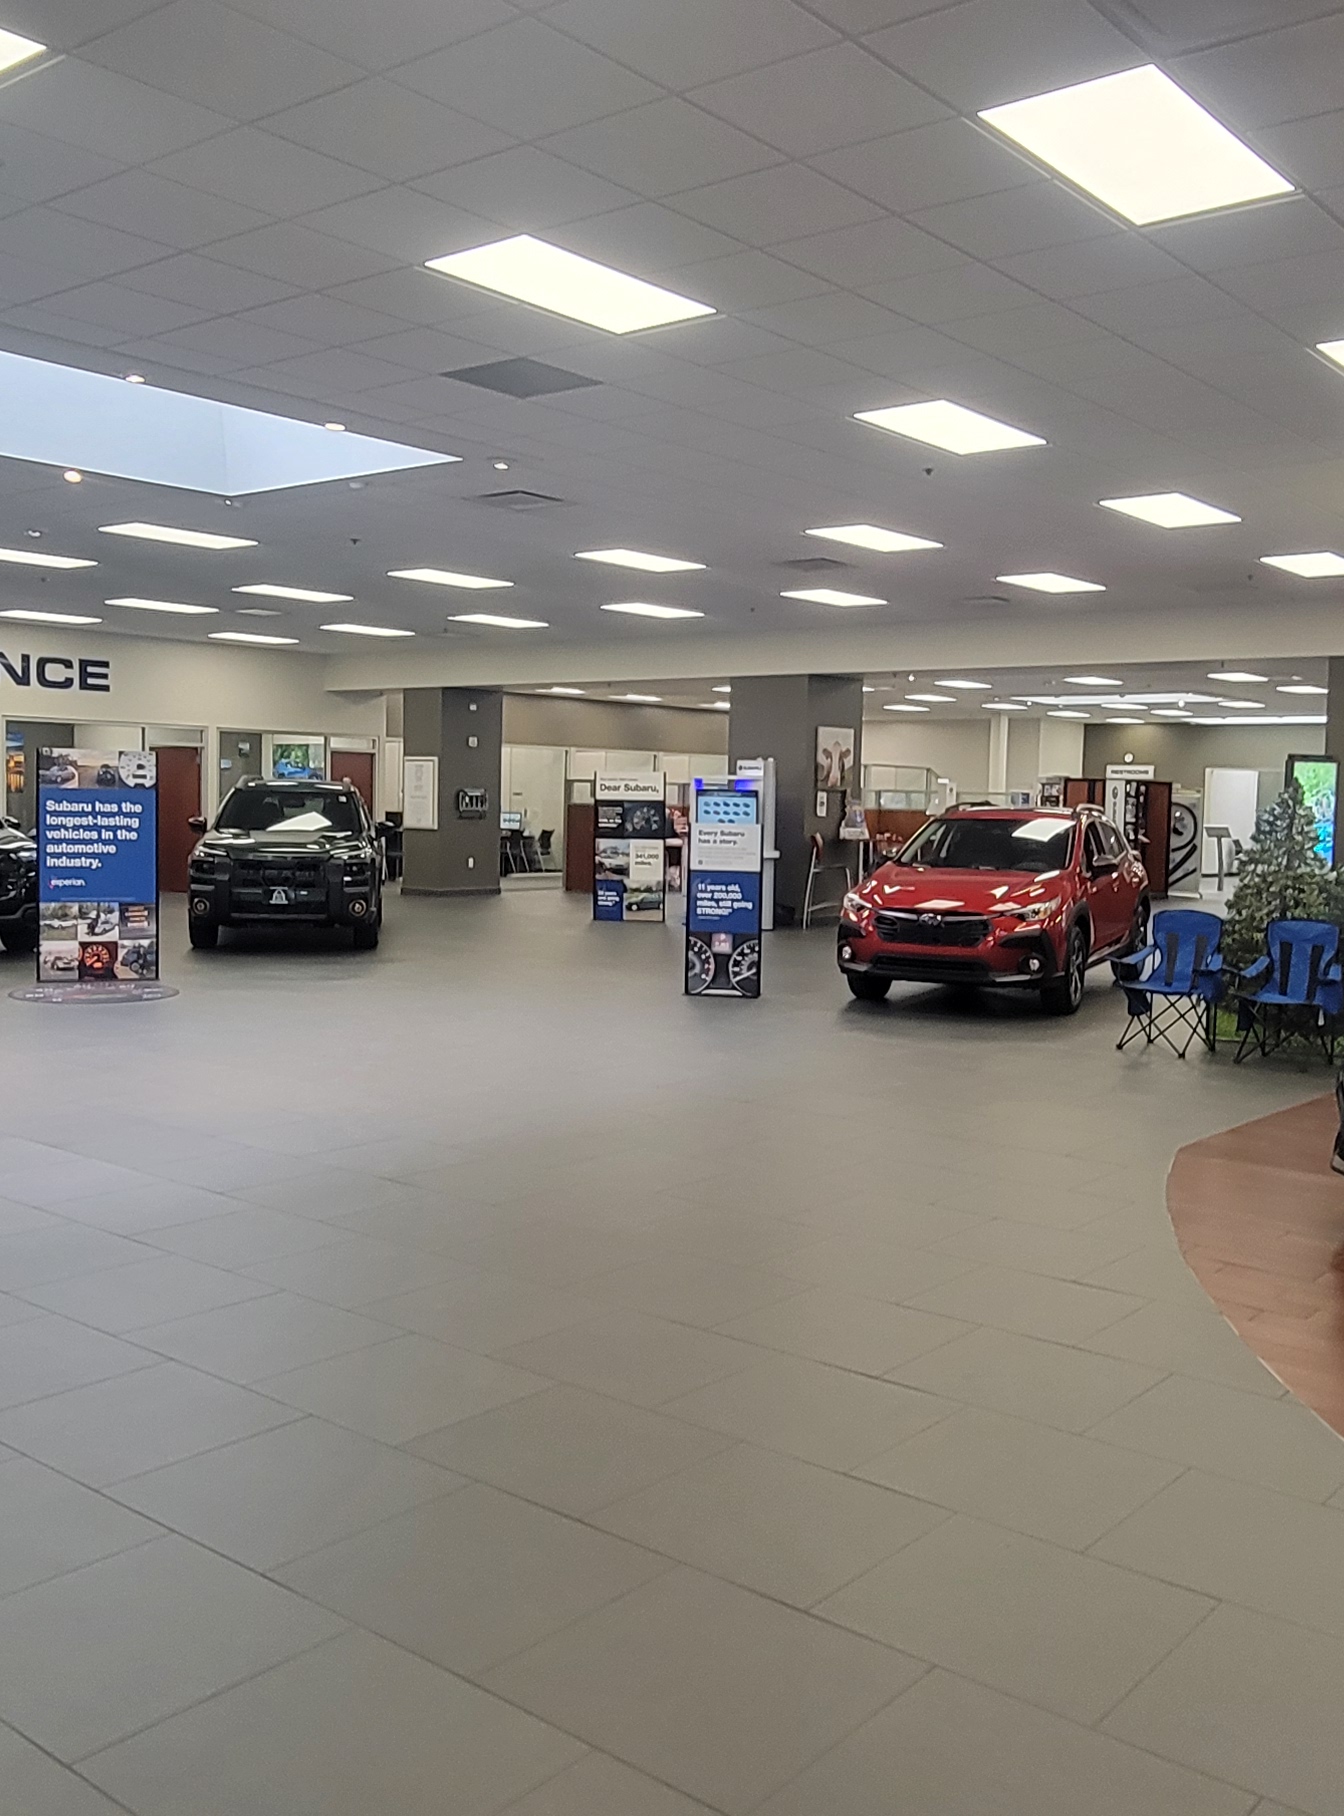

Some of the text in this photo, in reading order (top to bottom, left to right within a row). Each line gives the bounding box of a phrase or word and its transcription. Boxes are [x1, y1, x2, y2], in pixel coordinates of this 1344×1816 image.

[600, 783, 659, 793] Dear Subaru,
[45, 800, 143, 813] Subaru has the
[46, 814, 140, 829] longest-lasting
[45, 828, 138, 840] vehicles in the
[46, 843, 117, 854] automotive
[46, 856, 102, 869] industry.
[698, 883, 705, 891] 11
[707, 884, 726, 892] years
[733, 901, 753, 910] going
